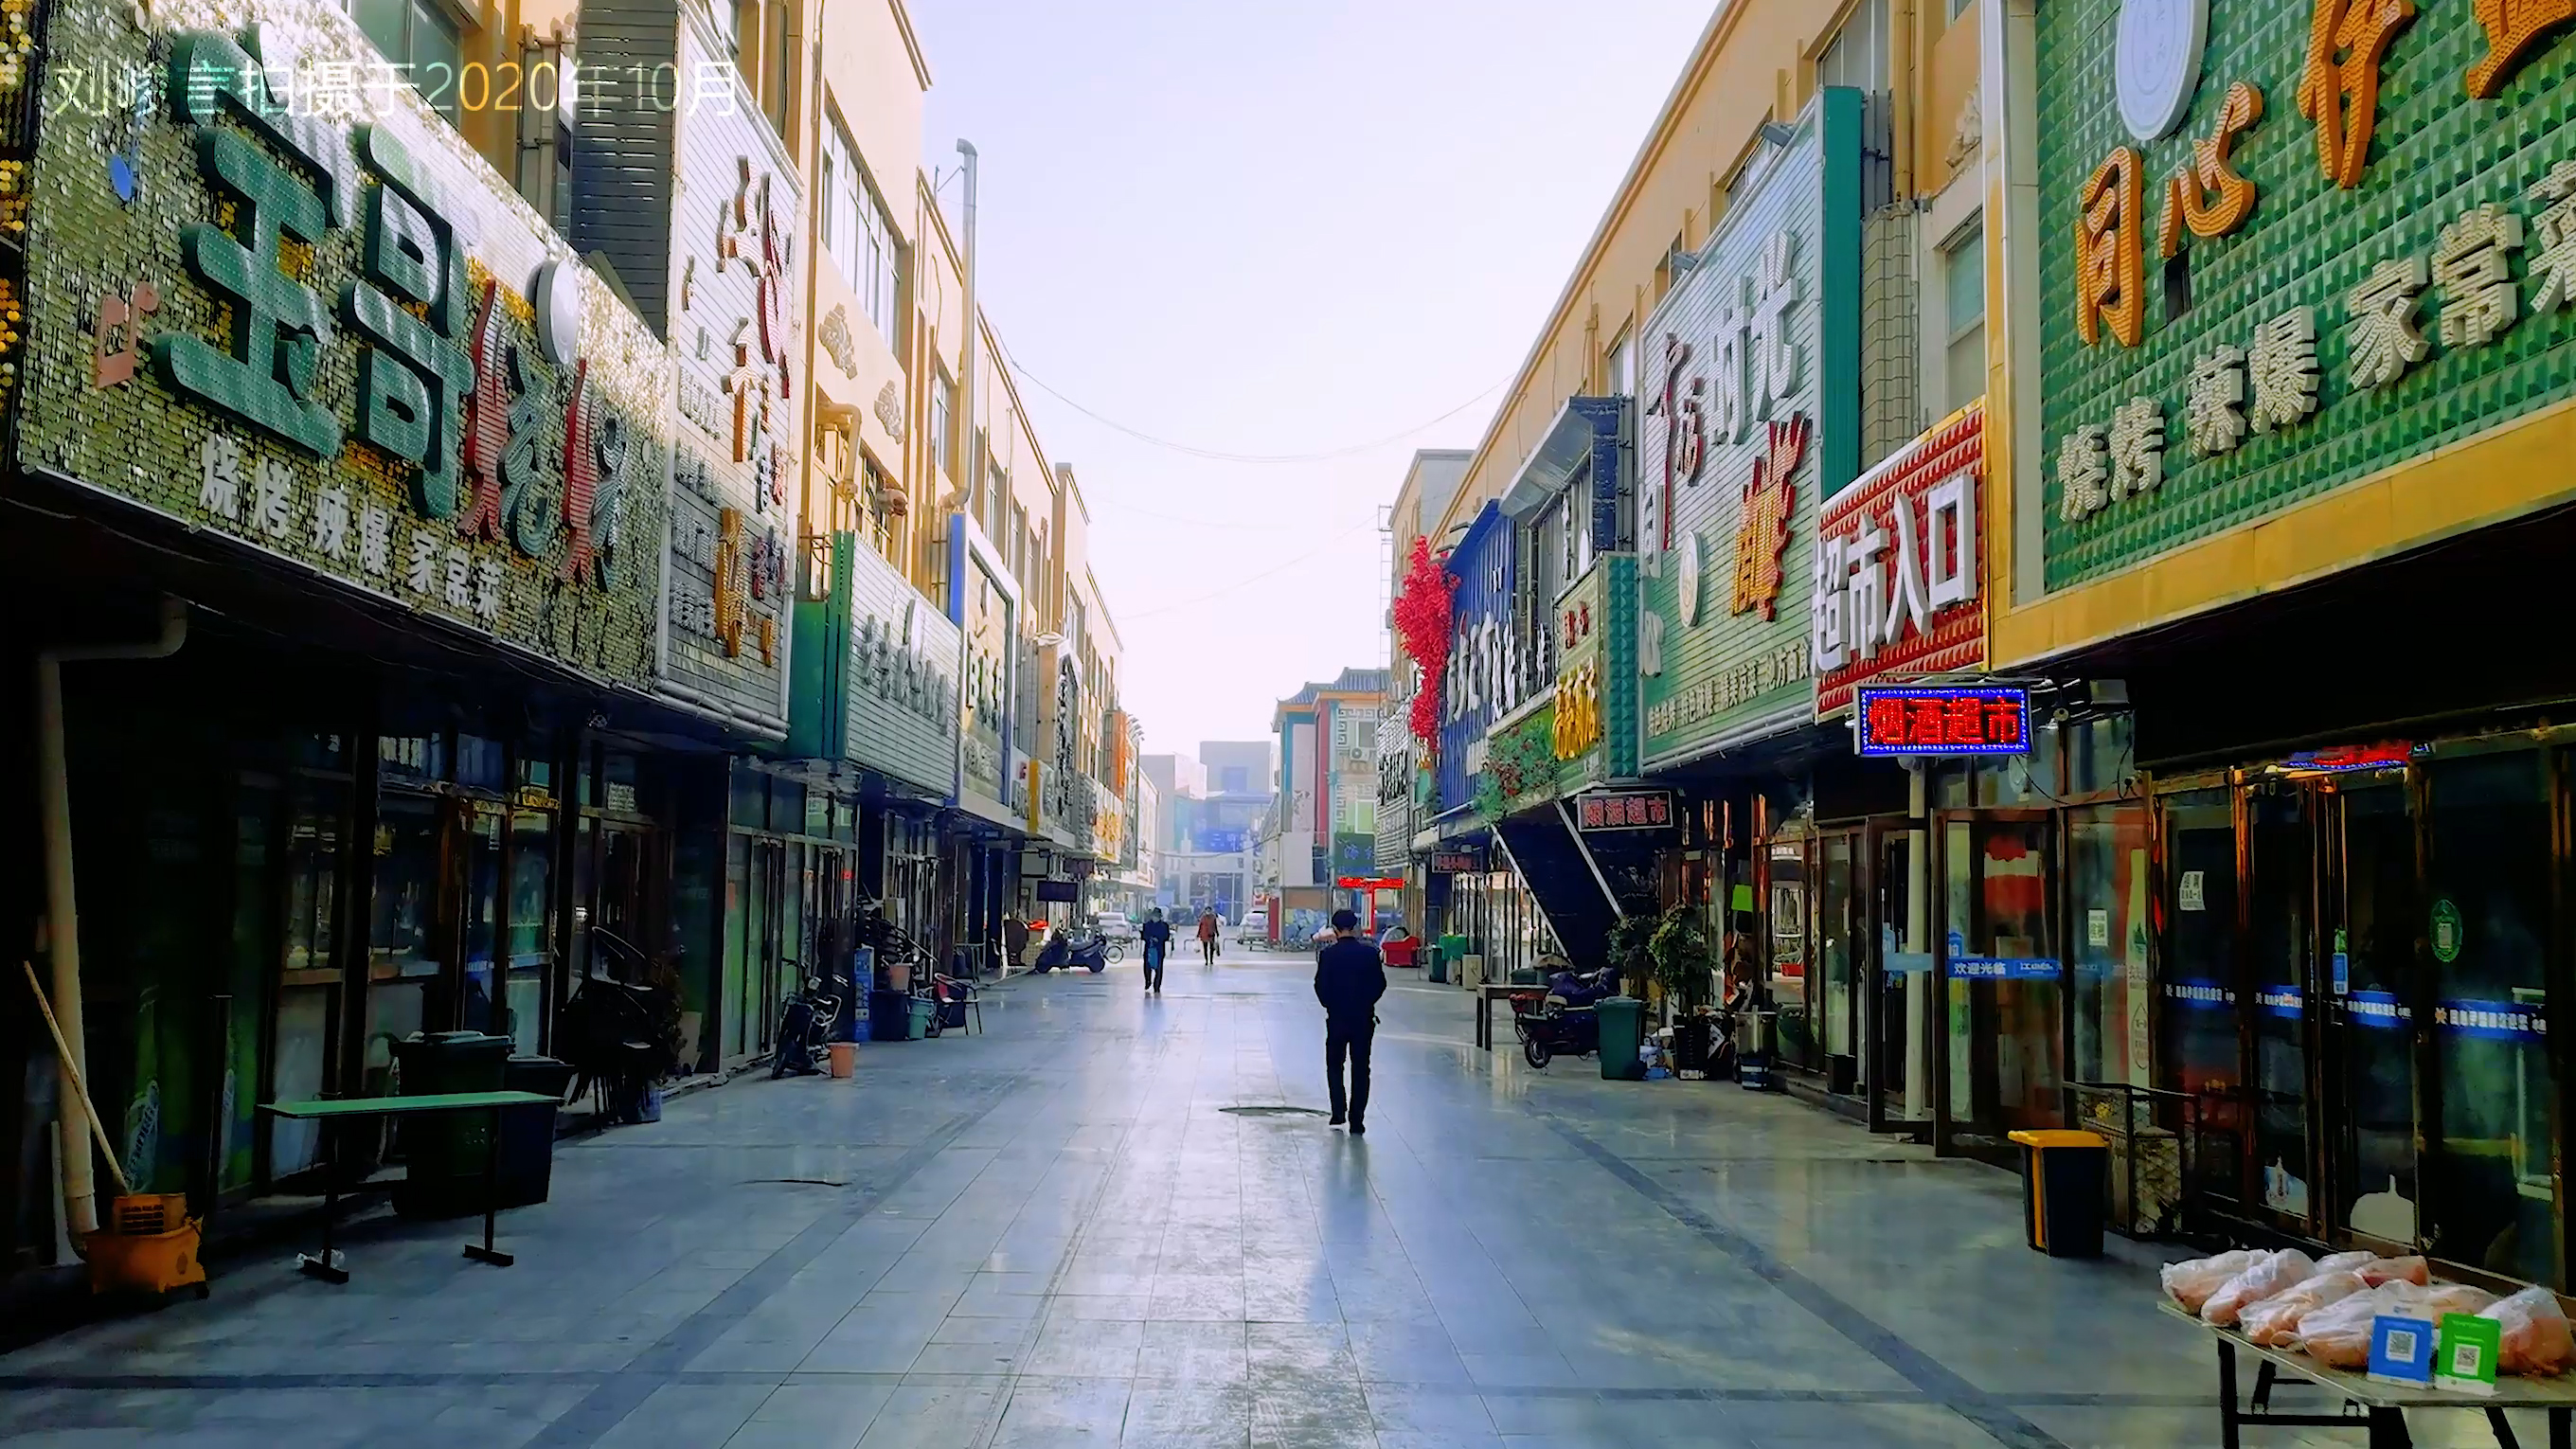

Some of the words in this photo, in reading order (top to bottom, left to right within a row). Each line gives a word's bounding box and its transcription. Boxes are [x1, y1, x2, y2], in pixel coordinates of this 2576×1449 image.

[2057, 395, 2164, 523] 烧烤
[200, 435, 293, 539] 烧烤
[408, 528, 502, 620] 家常菜
[1813, 473, 1977, 672] 超市入口
[1869, 696, 2021, 744] 烟酒超市
[1583, 796, 1668, 827] 烟酒超市
[1954, 961, 2007, 976] 欢迎光临
